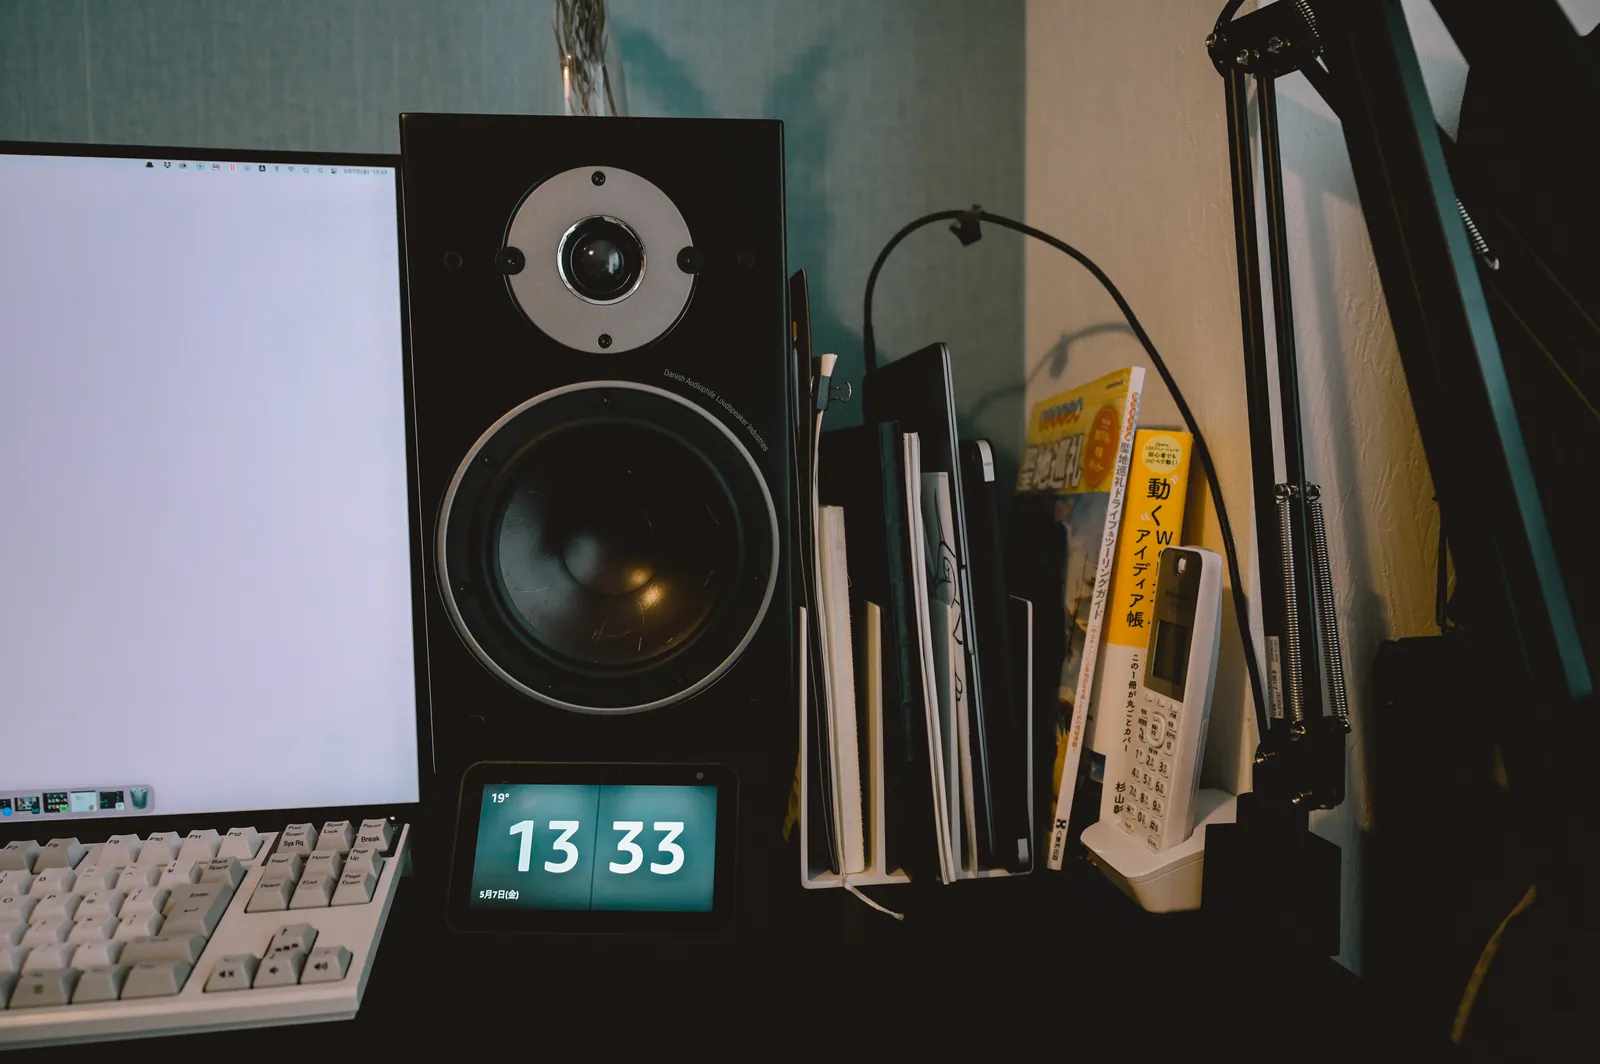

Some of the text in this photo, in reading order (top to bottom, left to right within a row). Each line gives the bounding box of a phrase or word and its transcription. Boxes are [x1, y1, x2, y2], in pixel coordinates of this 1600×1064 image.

[664, 368, 768, 452] Danish Audiophile Loudspeaker Industries
[1126, 529, 1151, 628] アイディア帳
[491, 792, 510, 803] 19°
[360, 835, 380, 843] Break
[510, 820, 685, 875] 13 33
[479, 890, 520, 900] 5月7日(金)
